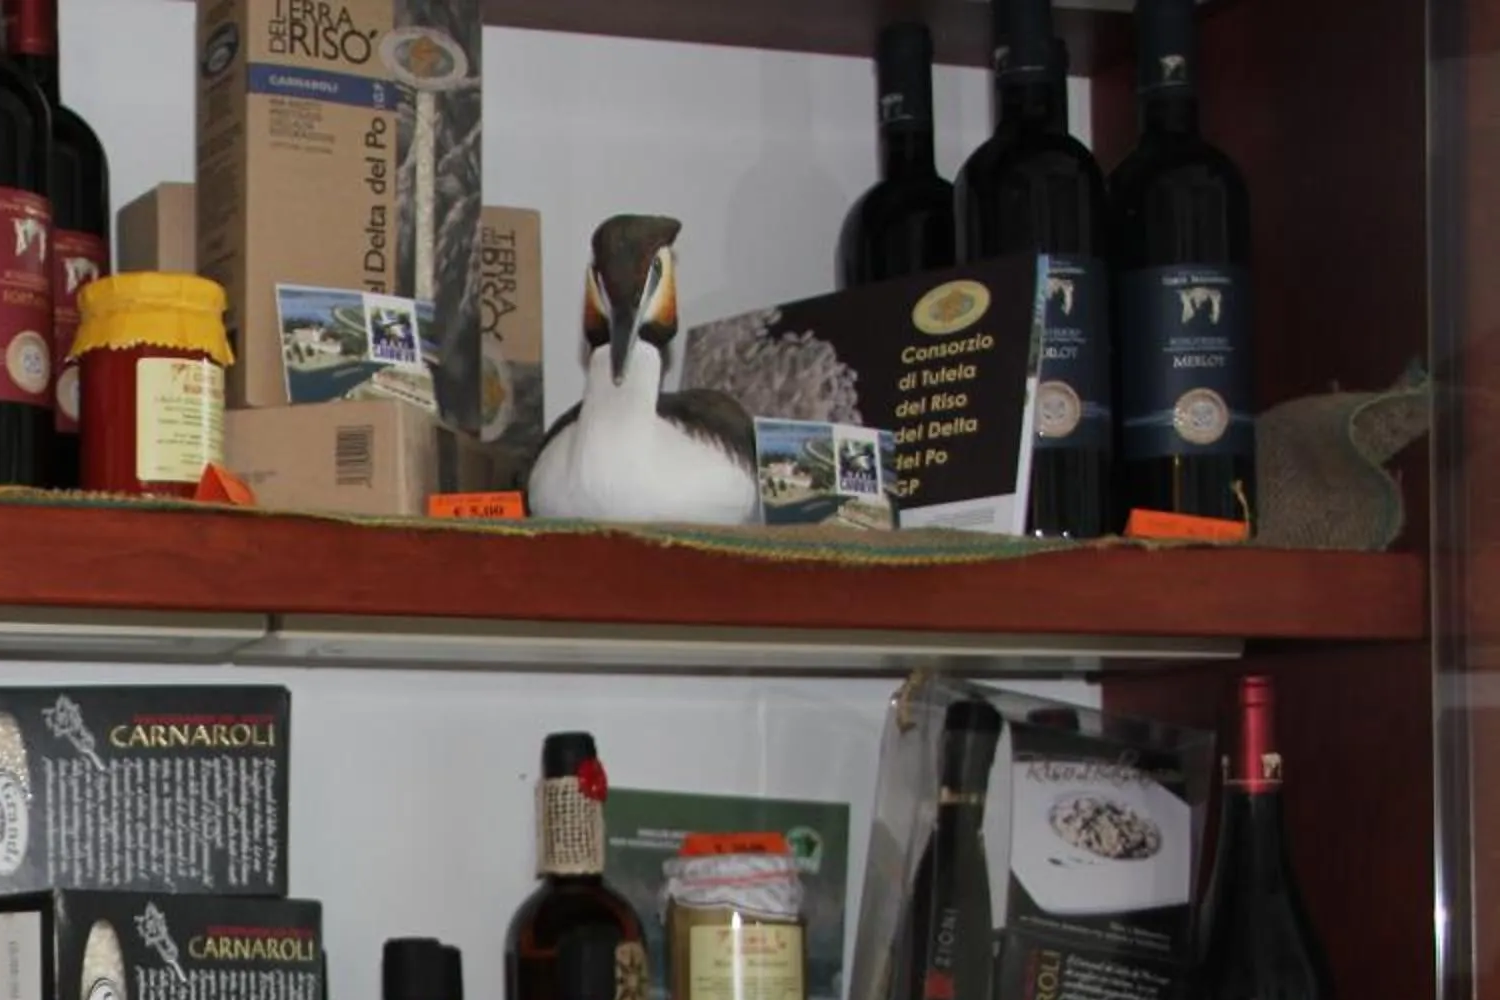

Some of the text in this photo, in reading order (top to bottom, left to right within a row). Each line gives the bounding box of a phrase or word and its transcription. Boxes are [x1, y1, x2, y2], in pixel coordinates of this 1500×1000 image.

[269, 18, 286, 53] DEL
[269, 74, 339, 94] CARNAROLI
[364, 117, 387, 149] Po
[364, 156, 386, 195] del
[364, 205, 386, 273] Delta
[496, 230, 518, 315] TERRA
[901, 334, 994, 363] Consorzio
[898, 364, 977, 391] di Tutela
[895, 391, 967, 417] del Riso
[893, 418, 977, 444] del Delta
[925, 448, 948, 467] Po
[895, 479, 920, 498] GP
[109, 723, 275, 747] CARNAROLI
[189, 937, 314, 961] CARNAROLI
